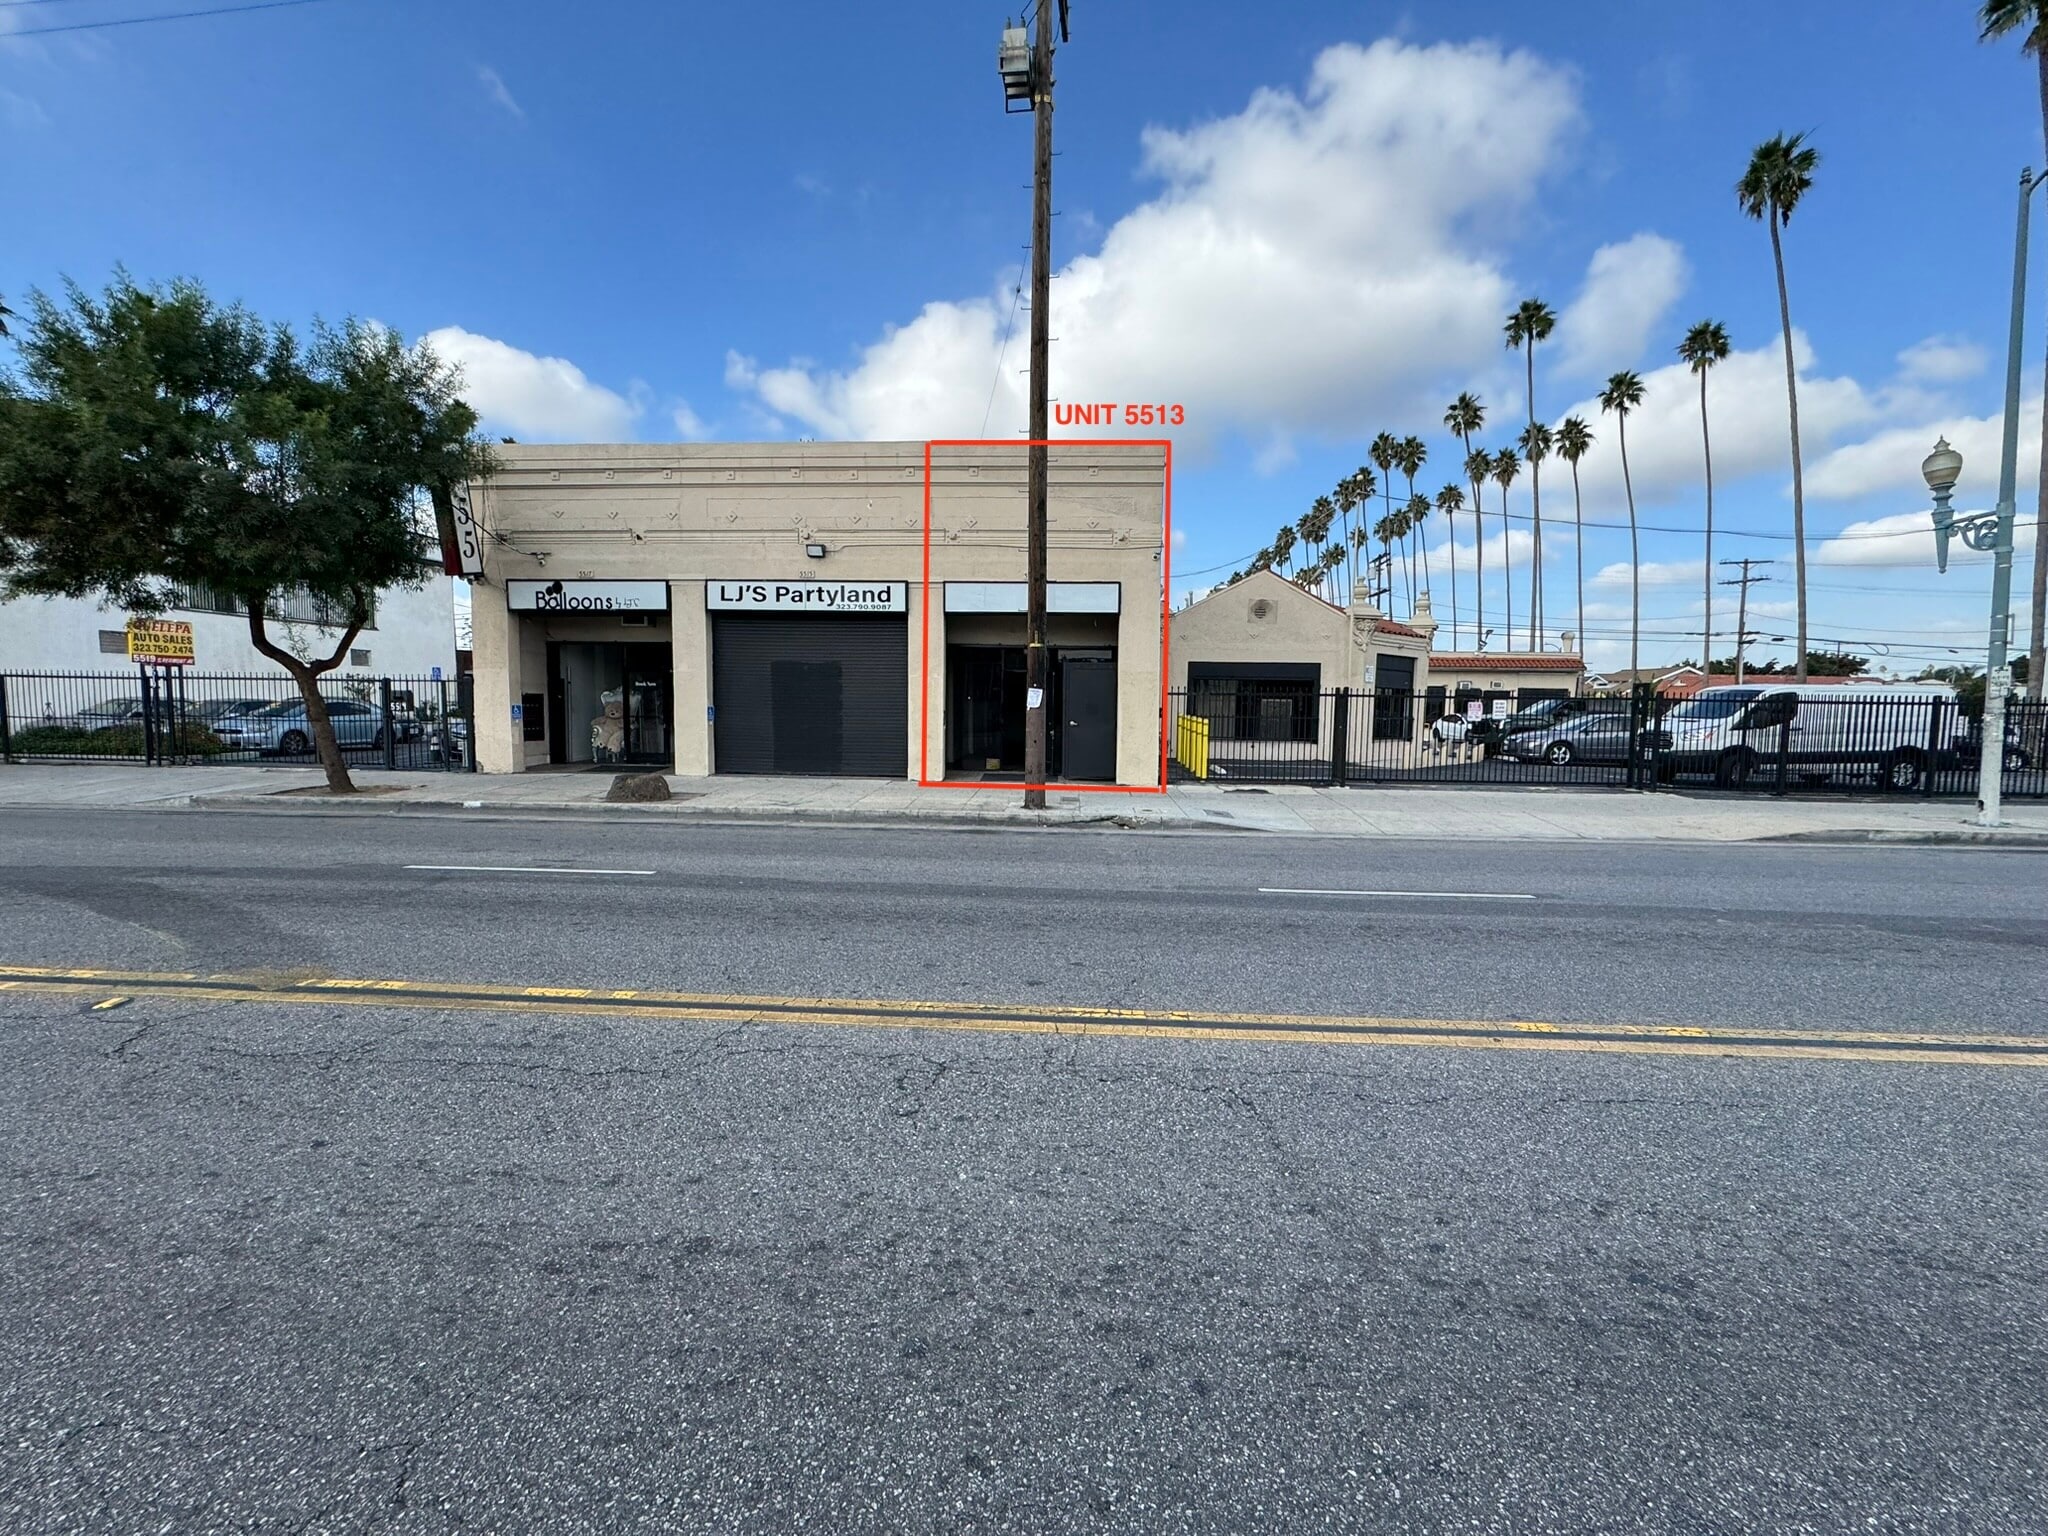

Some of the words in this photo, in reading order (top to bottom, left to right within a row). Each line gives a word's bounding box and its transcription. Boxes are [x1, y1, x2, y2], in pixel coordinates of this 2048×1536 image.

[536, 590, 613, 610] Balloons
[720, 585, 767, 602] LJ'S
[775, 585, 892, 607] Partyland
[133, 632, 160, 643] AUTO
[162, 634, 193, 645] SALES
[133, 655, 156, 663] 5519
